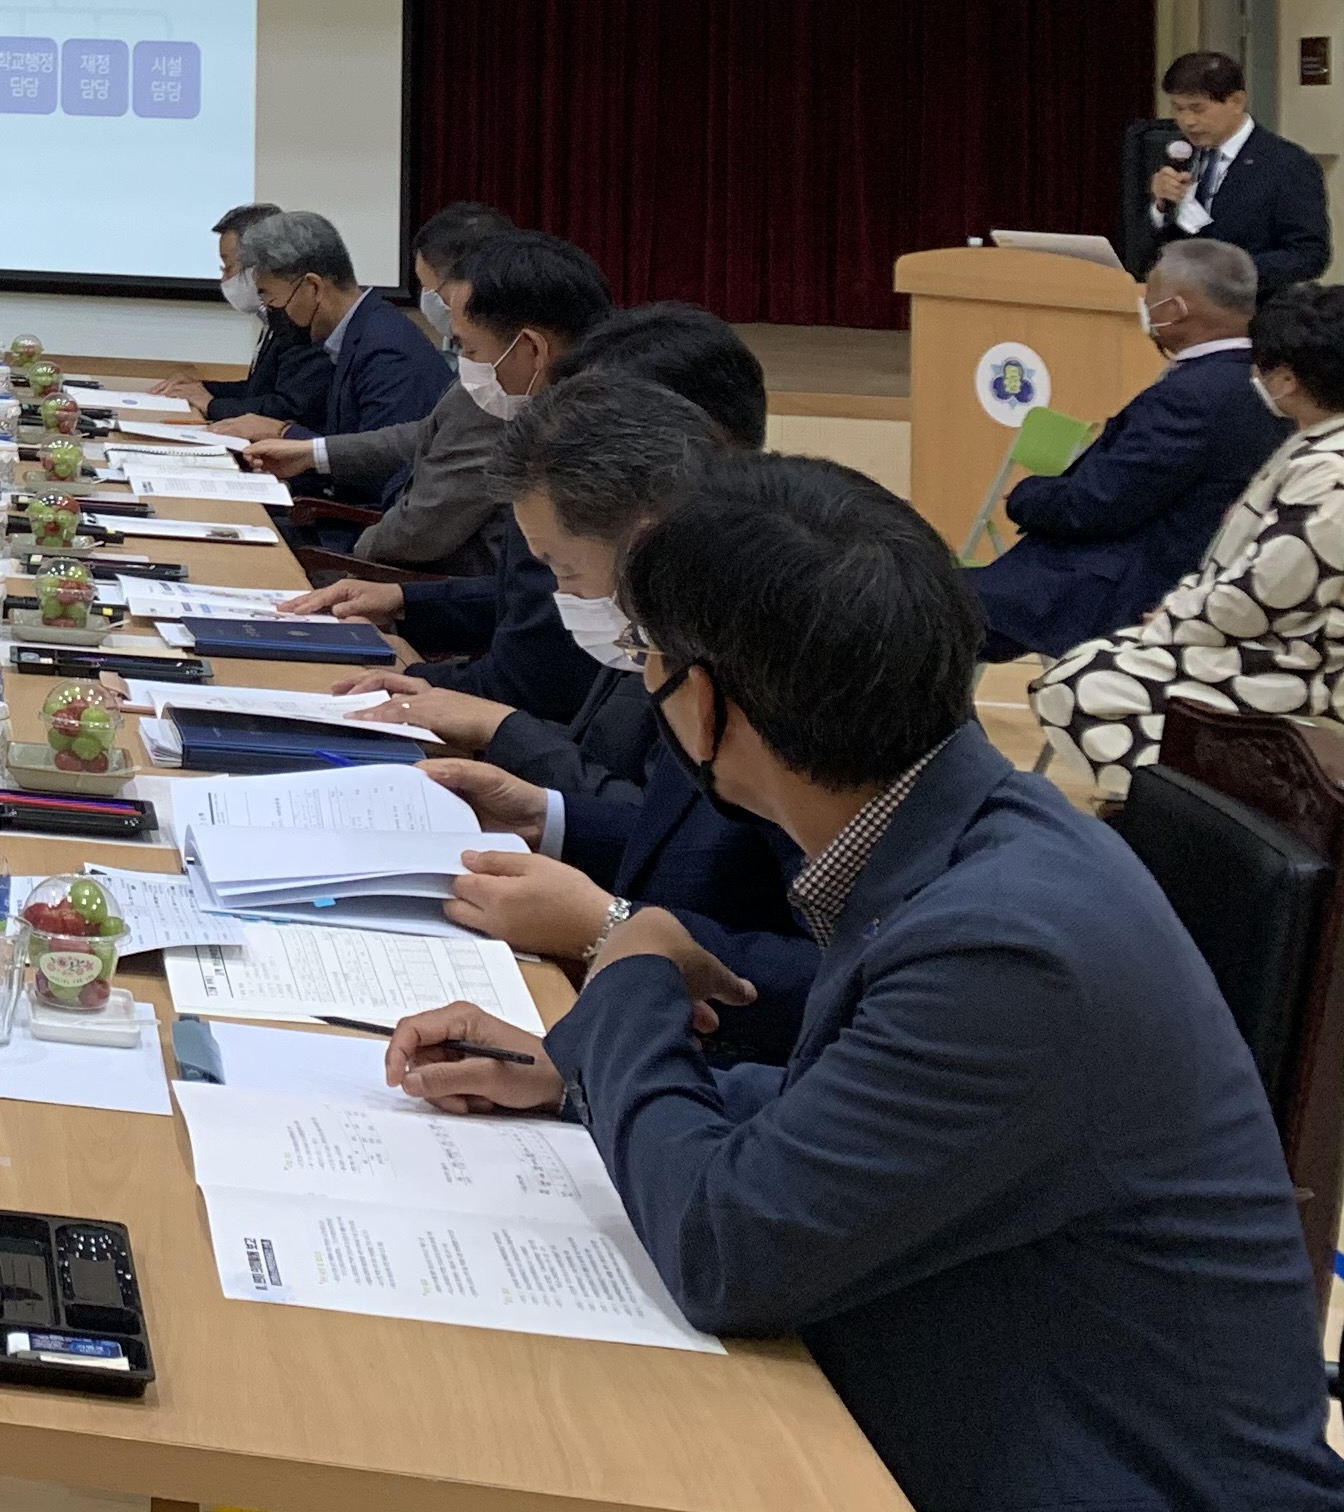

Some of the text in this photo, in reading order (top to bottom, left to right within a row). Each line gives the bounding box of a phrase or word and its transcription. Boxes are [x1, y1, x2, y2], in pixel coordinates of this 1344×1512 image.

[80, 54, 110, 76] 재정
[151, 56, 183, 78] 시설
[10, 76, 40, 99] 담당
[80, 78, 111, 101] 담당
[151, 81, 183, 103] 담당
